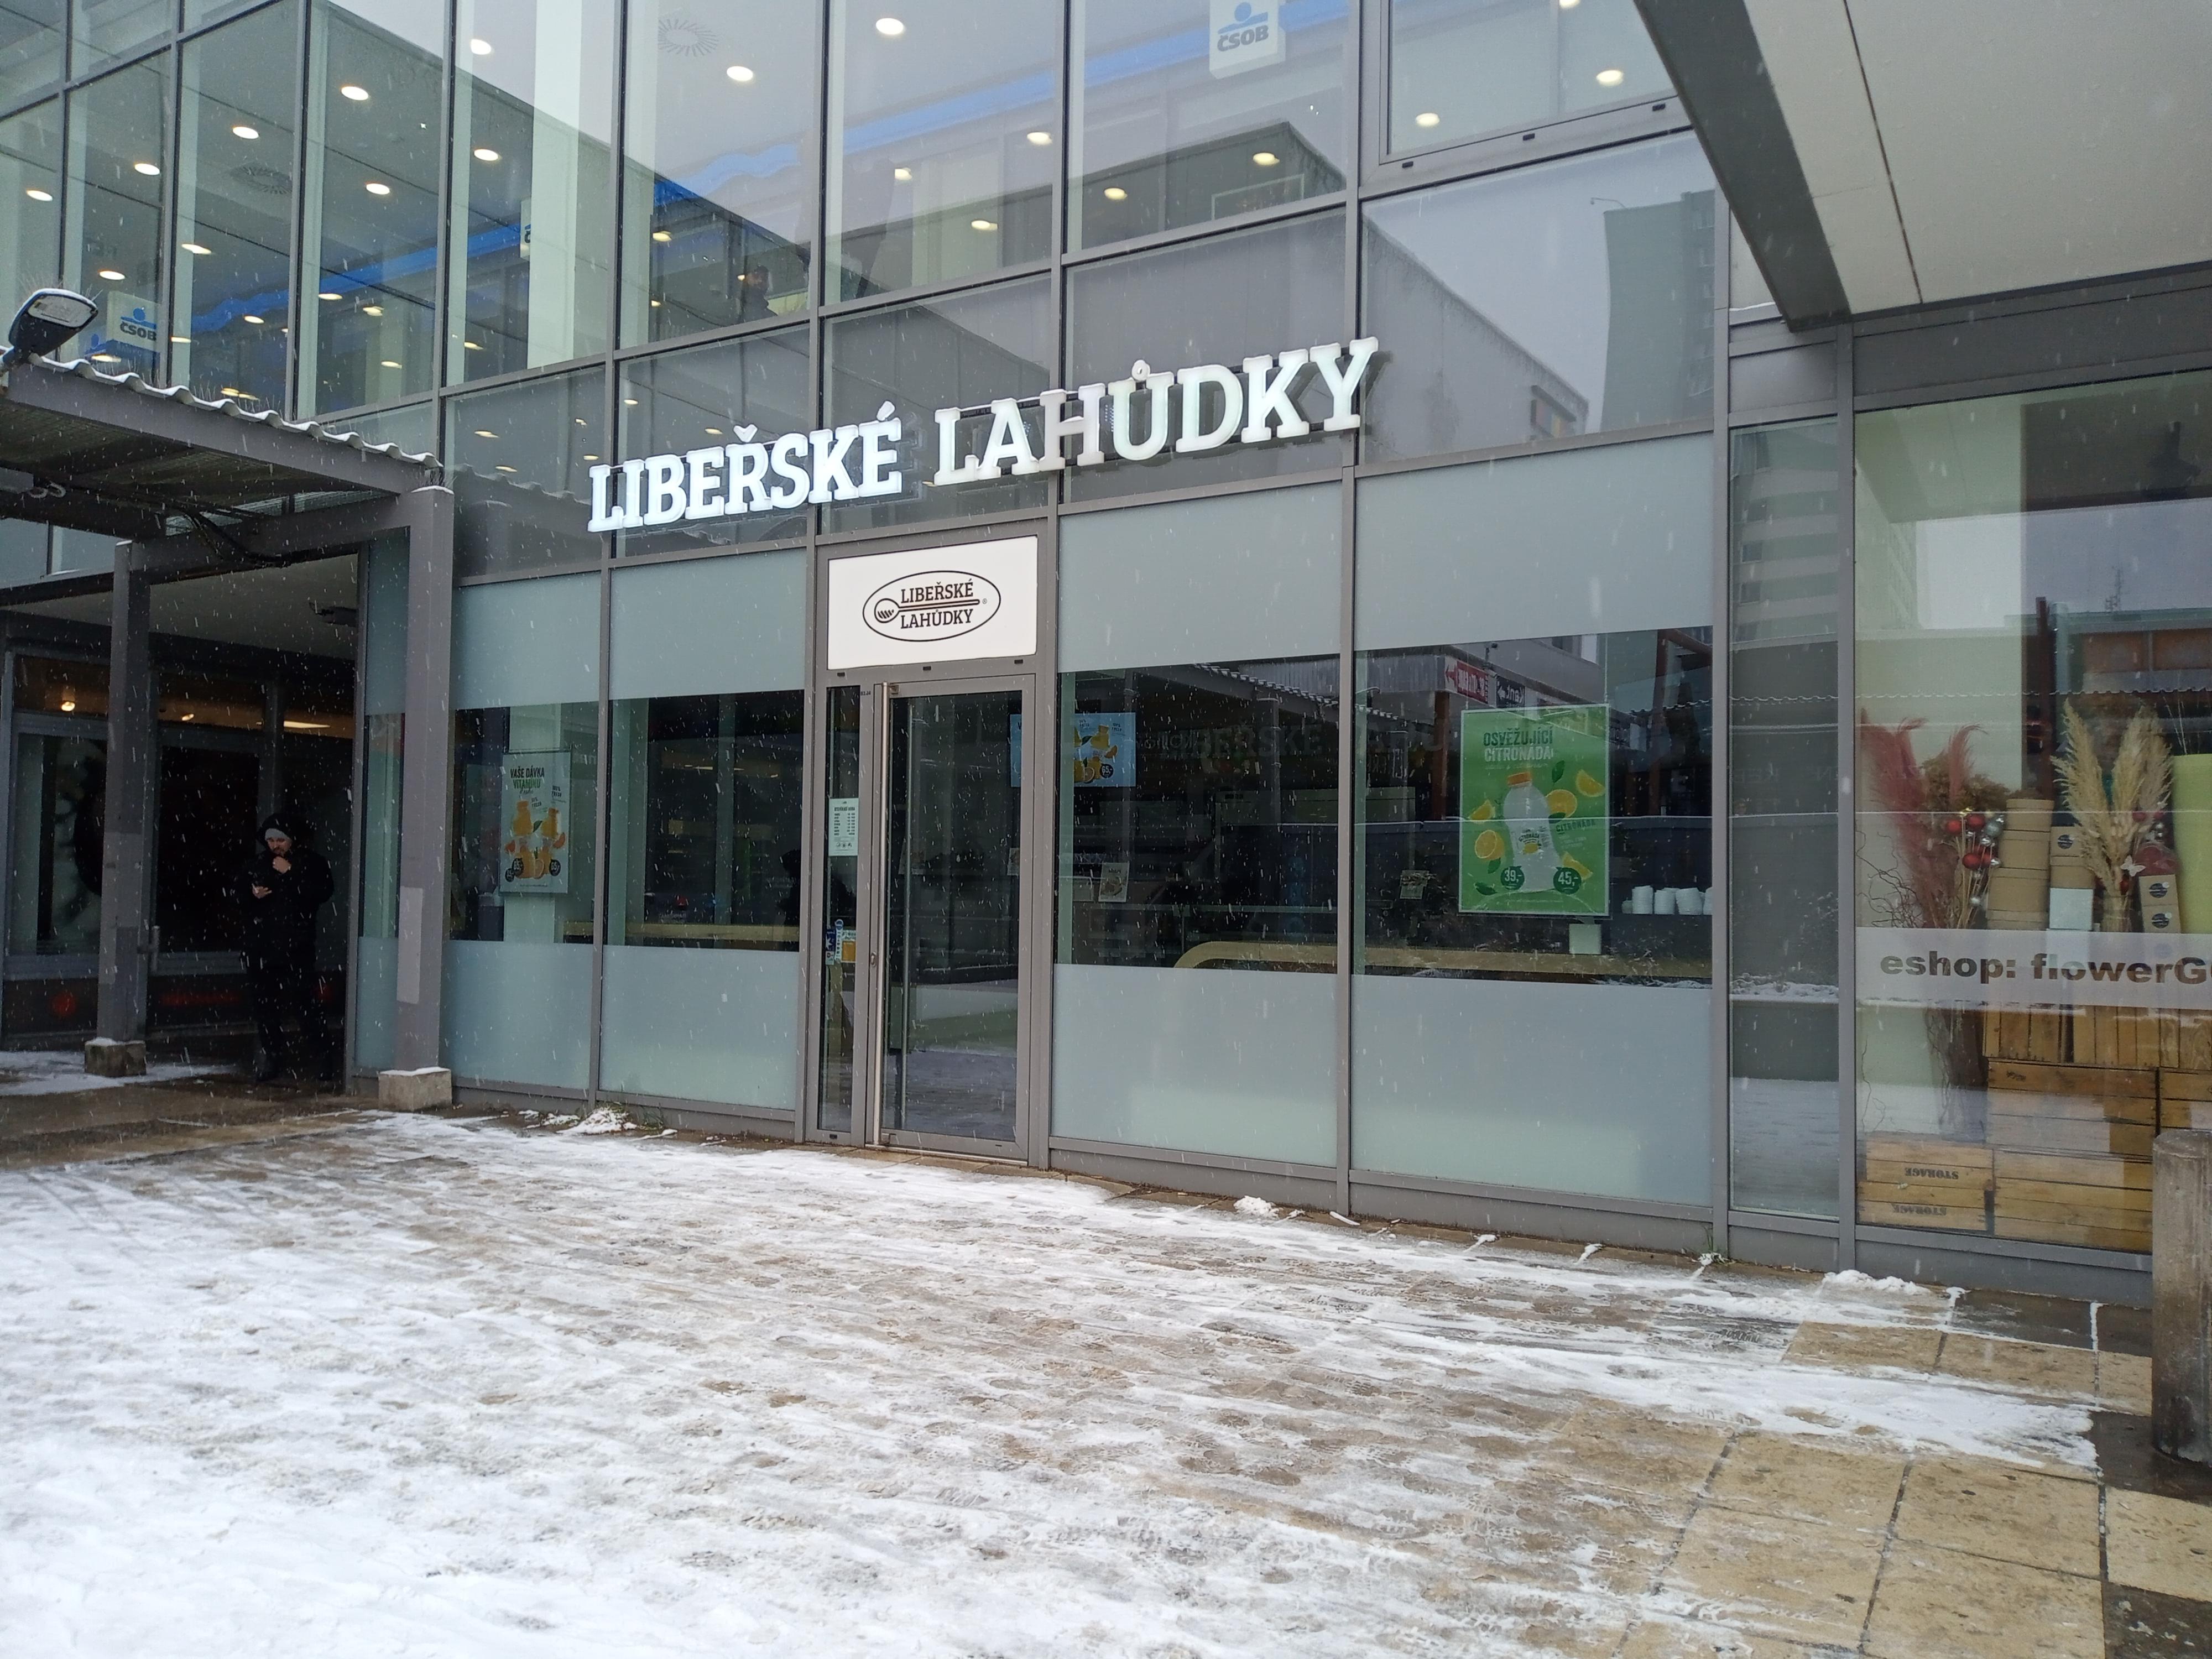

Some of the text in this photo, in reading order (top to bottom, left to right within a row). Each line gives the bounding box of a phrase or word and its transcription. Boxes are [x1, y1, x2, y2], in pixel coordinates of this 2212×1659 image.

[1217, 25, 1269, 52] ČSOB
[120, 321, 157, 341] ČSOB
[588, 336, 1379, 532] LIBEŘSKÉ LAHŮDKY
[901, 578, 973, 604] LIBEŘSKÉ
[900, 609, 973, 629] LAHŮDKY
[1483, 726, 1553, 746] OSVĚŽUJÍCÍ
[1485, 743, 1551, 762] CITRONÁDA
[510, 765, 545, 779] VAŠE DÁVKA
[513, 778, 541, 789] VITAMÍNU
[1504, 869, 1522, 883] 39,-
[1558, 872, 1578, 886] 45,-
[1881, 951, 2212, 985] eshop: flowerG
[1905, 1167, 1959, 1180] STORAGE
